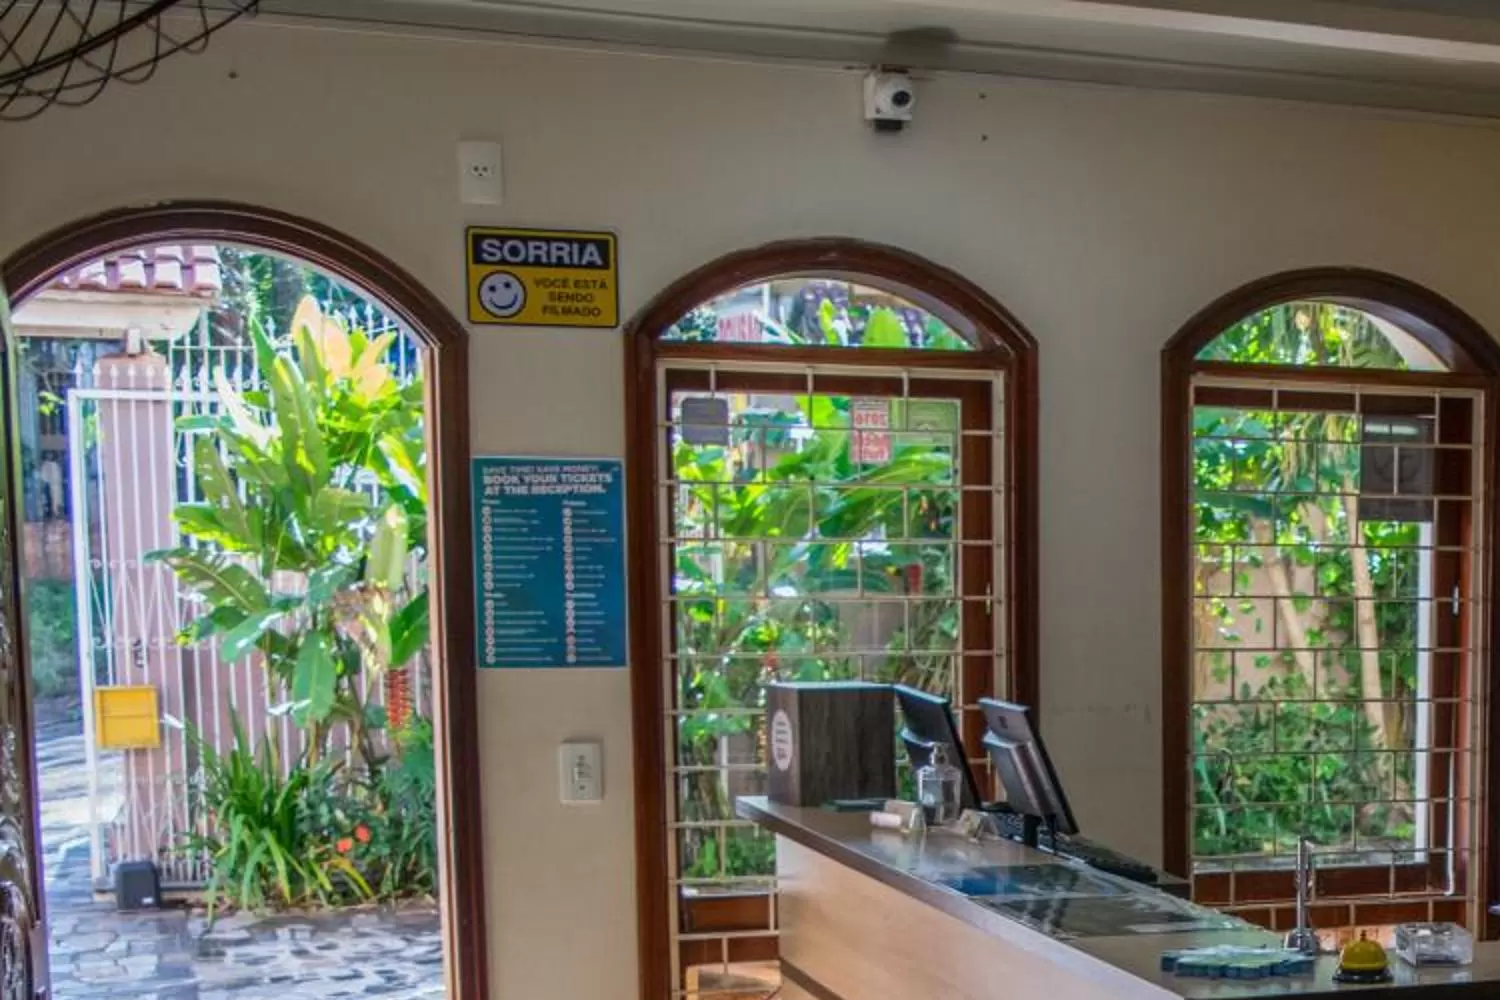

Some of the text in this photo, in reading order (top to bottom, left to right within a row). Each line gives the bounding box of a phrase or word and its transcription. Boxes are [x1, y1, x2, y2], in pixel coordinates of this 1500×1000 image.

[480, 238, 604, 266] SORRIA
[548, 291, 594, 303] SENDO
[541, 305, 602, 318] FILMADO
